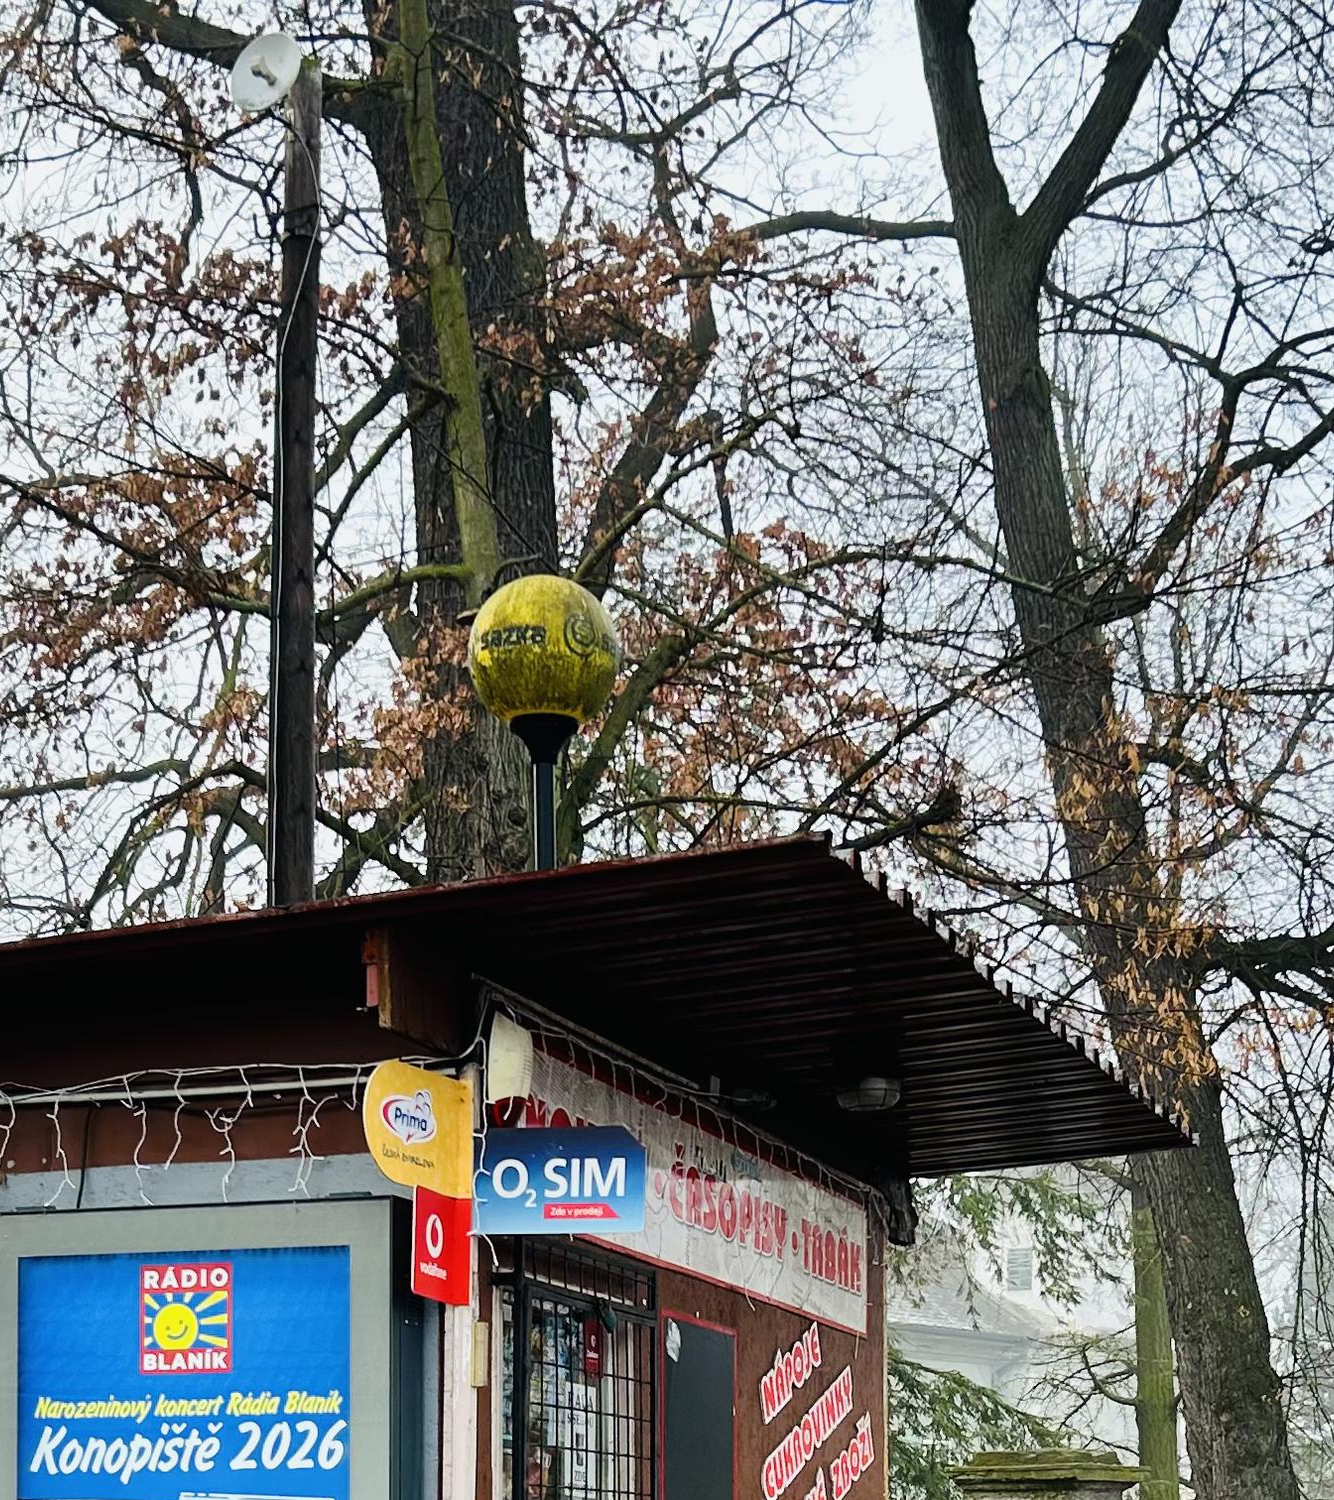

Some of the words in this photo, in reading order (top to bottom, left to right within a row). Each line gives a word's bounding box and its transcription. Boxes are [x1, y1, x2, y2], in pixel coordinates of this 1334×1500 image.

[394, 1106, 428, 1132] Prima
[543, 1157, 626, 1198] SIM
[549, 1206, 566, 1217] Zde
[573, 1206, 604, 1218] prodeji
[669, 1142, 787, 1263] ČASOPISY
[801, 1225, 862, 1296] TABÁK
[143, 1266, 229, 1290] RÁDIO
[419, 1261, 448, 1281] vodafone
[143, 1348, 228, 1372] BLANÍK
[761, 1321, 822, 1425] NÁPOJE
[34, 1394, 152, 1423] Narozeninový
[154, 1393, 223, 1417] koncert
[226, 1390, 281, 1417] Rádia
[283, 1389, 343, 1415] Blaník
[30, 1422, 223, 1484] Konopiště
[229, 1419, 348, 1472] 2026
